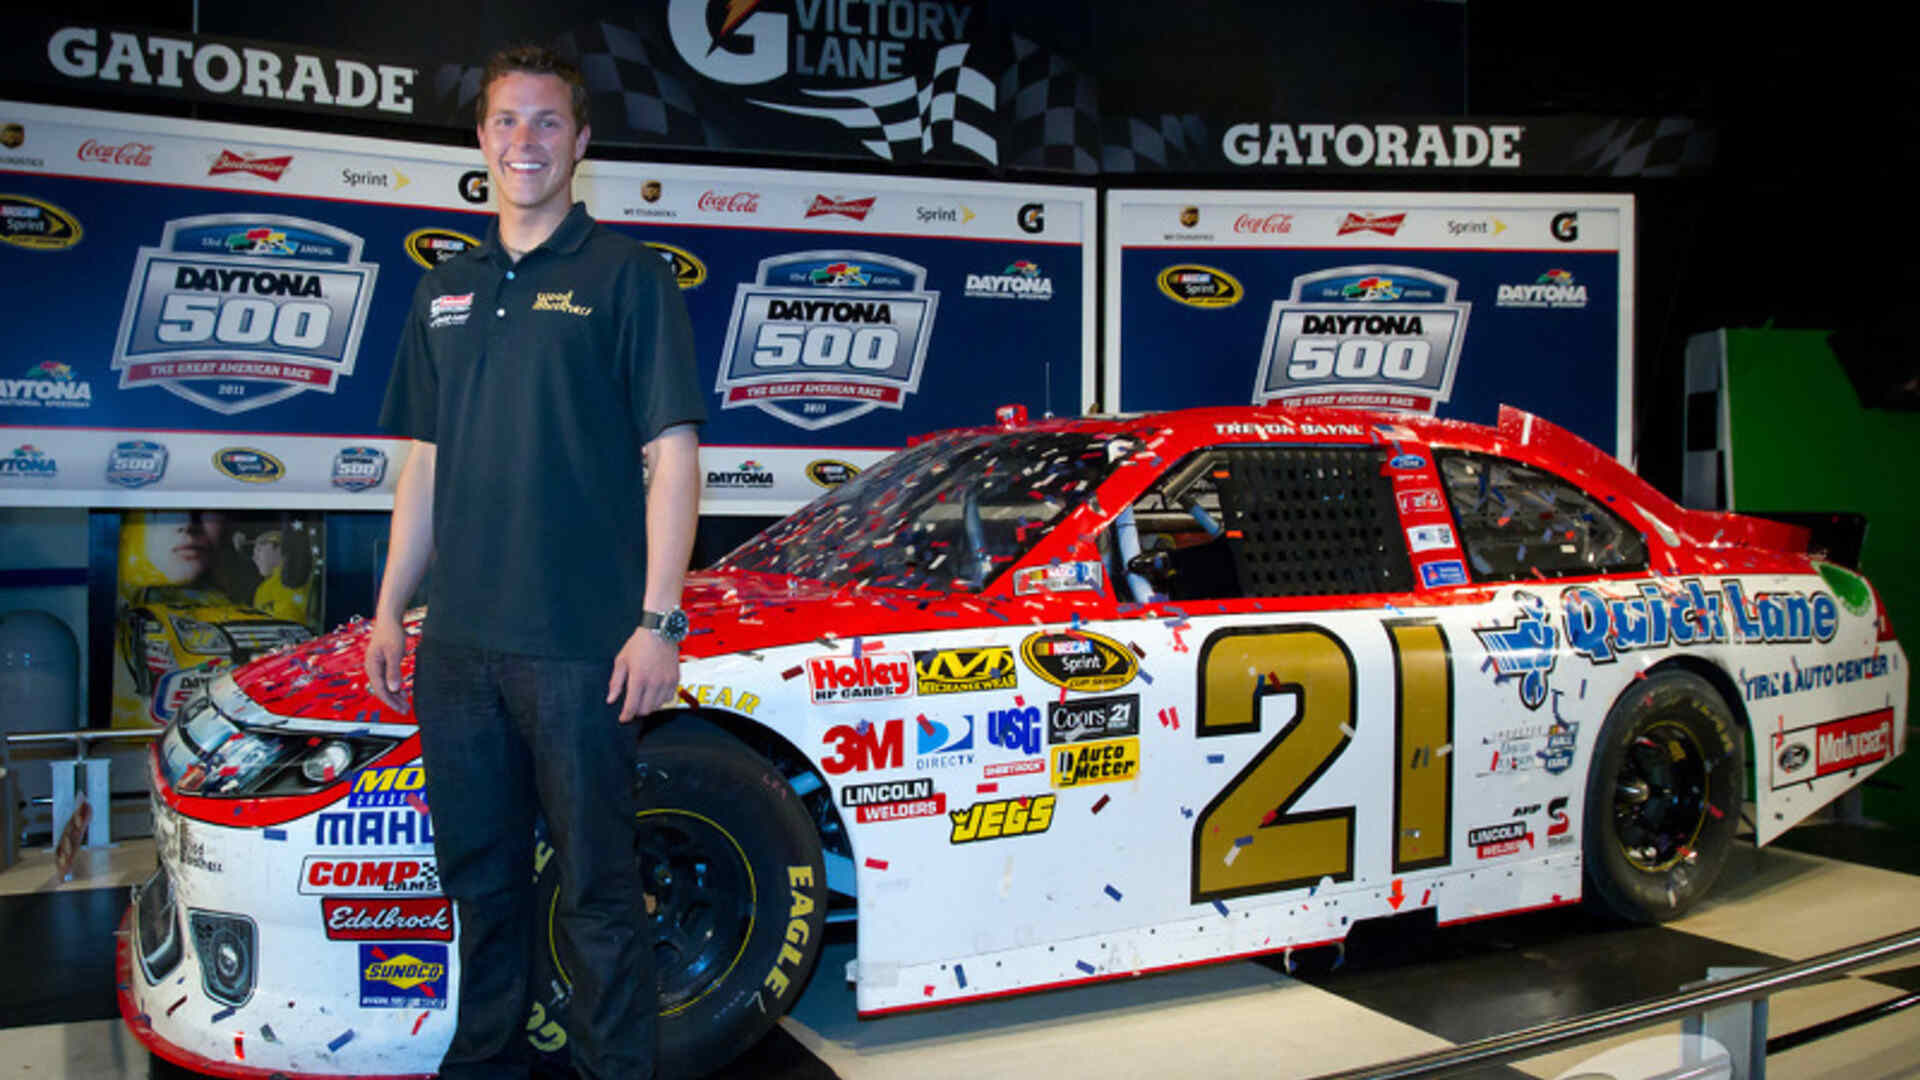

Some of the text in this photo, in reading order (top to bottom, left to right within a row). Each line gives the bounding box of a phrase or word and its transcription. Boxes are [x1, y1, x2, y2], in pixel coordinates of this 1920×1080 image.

[795, 0, 973, 40] VICTORY
[48, 26, 414, 114] GATORADE
[796, 35, 905, 81] LANE
[77, 138, 154, 167] Coca-Cola
[1222, 123, 1523, 168] GATORADE
[342, 168, 388, 187] Sprint
[458, 170, 488, 204] G
[697, 190, 760, 213] Coca-Cola
[916, 207, 957, 223] Sprint
[1017, 203, 1045, 234] G
[1233, 213, 1294, 234] Coca-Cola
[1551, 211, 1578, 242] G
[1448, 220, 1487, 236] Sprint
[175, 266, 322, 298] DAYTONA
[965, 273, 1052, 294] DAYTONA
[1497, 284, 1587, 301] DAYTONA
[158, 294, 334, 349] 500
[766, 300, 892, 325] DAYTONA
[1301, 315, 1423, 335] DAYTONA
[753, 325, 899, 369] 500
[1288, 338, 1432, 380] 500
[151, 362, 313, 380] THE GREAT AMERICAN RACE
[218, 385, 246, 396] 2011
[1214, 422, 1296, 436] TREVOR
[707, 472, 773, 484] DAYTONA
[1562, 579, 1838, 665] Quick Lane
[811, 656, 911, 695] Holley
[1062, 655, 1101, 673] Sprint
[1795, 662, 1834, 692] AUTO
[1836, 654, 1888, 684] CENTER
[1053, 706, 1106, 729] Coors
[1109, 703, 1132, 721] 21
[987, 706, 1042, 756] USG
[1819, 720, 1891, 767] Motorcraft
[820, 718, 904, 775] 3M
[1077, 745, 1125, 762] Auto
[916, 754, 975, 770] DIRECTV
[1074, 760, 1136, 781] Meter
[1190, 617, 1456, 905] 21
[846, 781, 929, 804] LINCOLN
[865, 801, 938, 821] WELDERS
[951, 793, 1057, 844] JEGS
[1471, 823, 1524, 845] LINCOLN
[308, 860, 421, 887] COMP
[383, 881, 439, 892] CAMS
[329, 905, 450, 930] Edelbrock
[764, 865, 815, 999] EAGLE
[367, 963, 442, 979] SUNOCO
